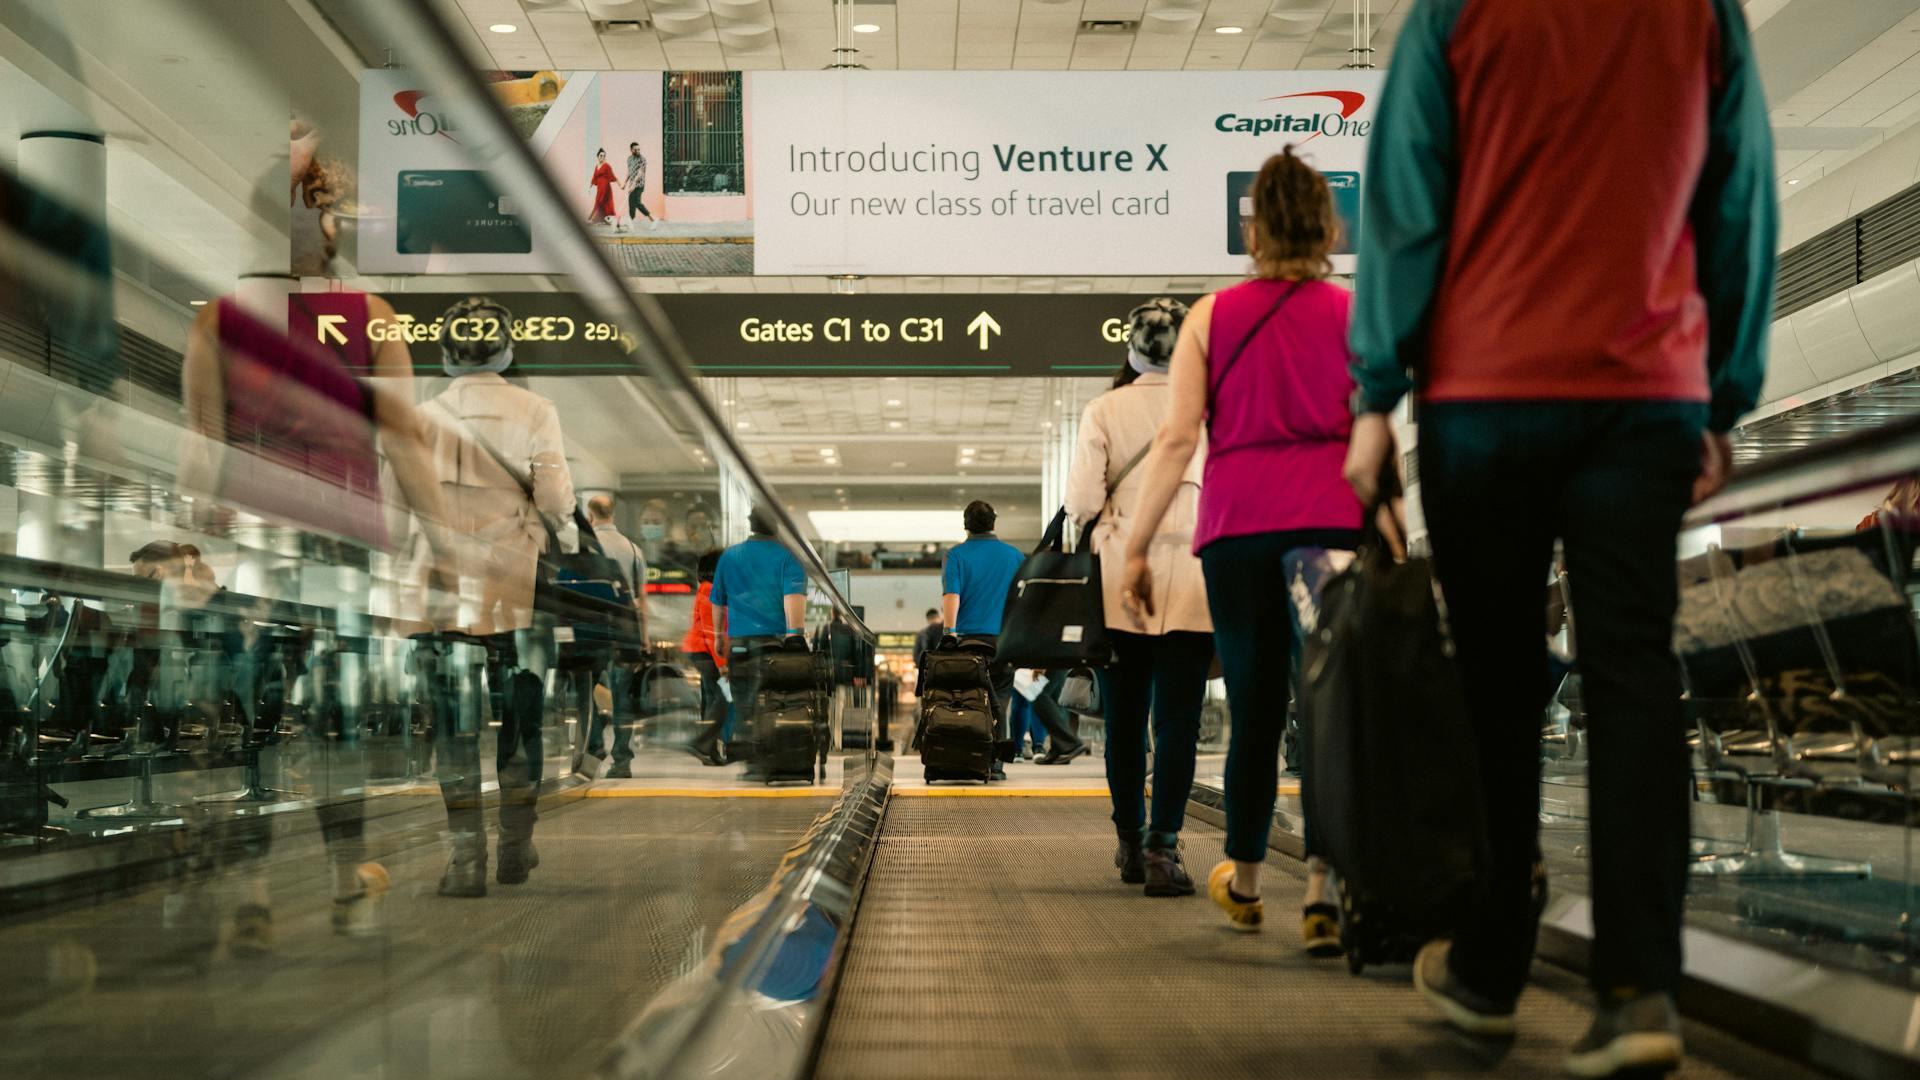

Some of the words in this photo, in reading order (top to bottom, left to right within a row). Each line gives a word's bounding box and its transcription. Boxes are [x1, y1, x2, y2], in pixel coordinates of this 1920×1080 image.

[790, 142, 980, 181] Introducing
[993, 144, 1133, 172] Venture
[1145, 144, 1169, 172] X
[790, 191, 840, 216] Our
[850, 198, 907, 216] new
[915, 190, 982, 216] class
[991, 189, 1019, 216] of
[1026, 190, 1102, 216] travel
[1111, 189, 1170, 216] card
[366, 318, 441, 342] Gates
[449, 318, 500, 342] C32
[740, 318, 813, 342] Gates
[823, 318, 851, 342] C1
[861, 319, 891, 342] to
[900, 318, 943, 342] C31
